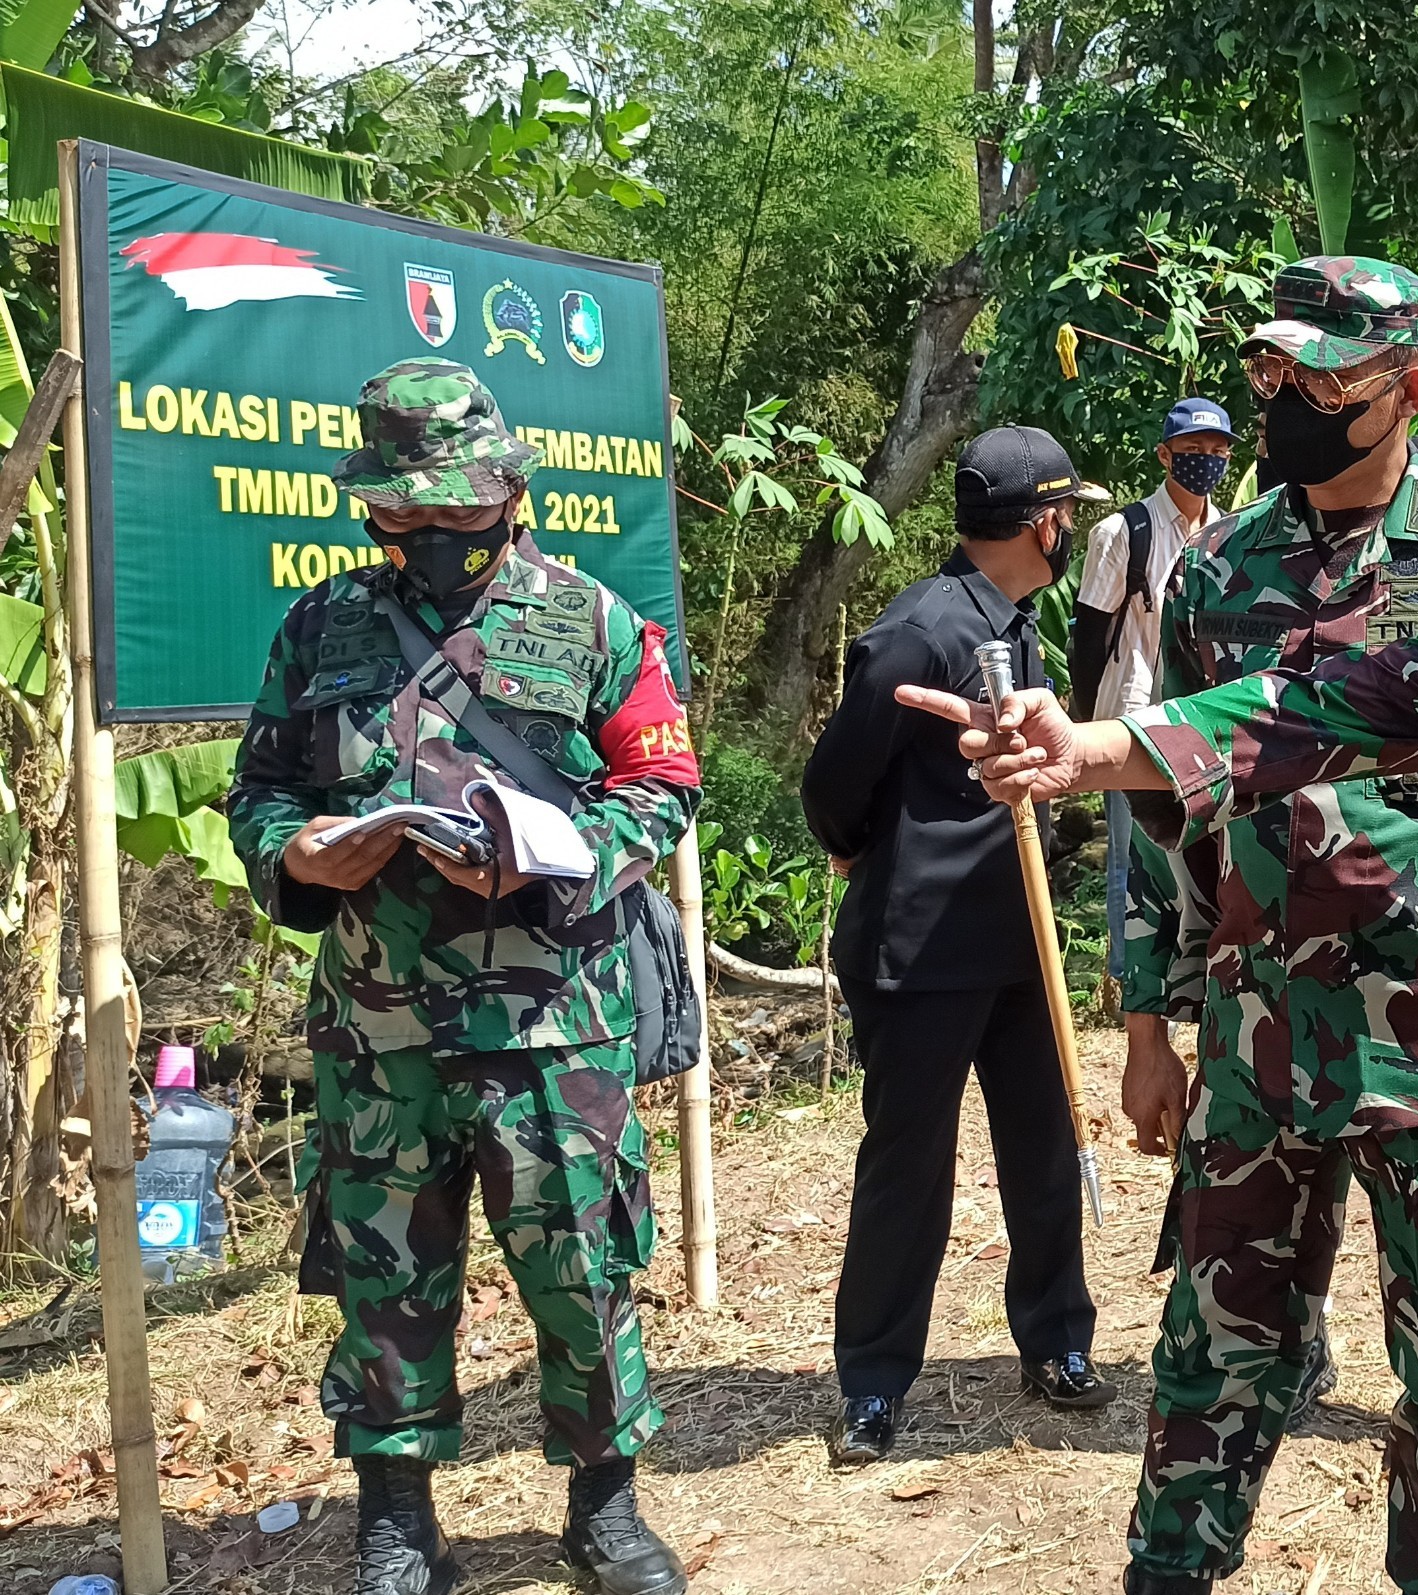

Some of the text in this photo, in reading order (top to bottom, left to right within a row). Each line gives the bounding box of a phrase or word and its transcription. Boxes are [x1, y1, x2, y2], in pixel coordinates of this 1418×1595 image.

[119, 381, 280, 442] LOKASI
[213, 465, 338, 518] TMMD
[545, 491, 620, 534] 2021
[497, 636, 549, 661] TNI
